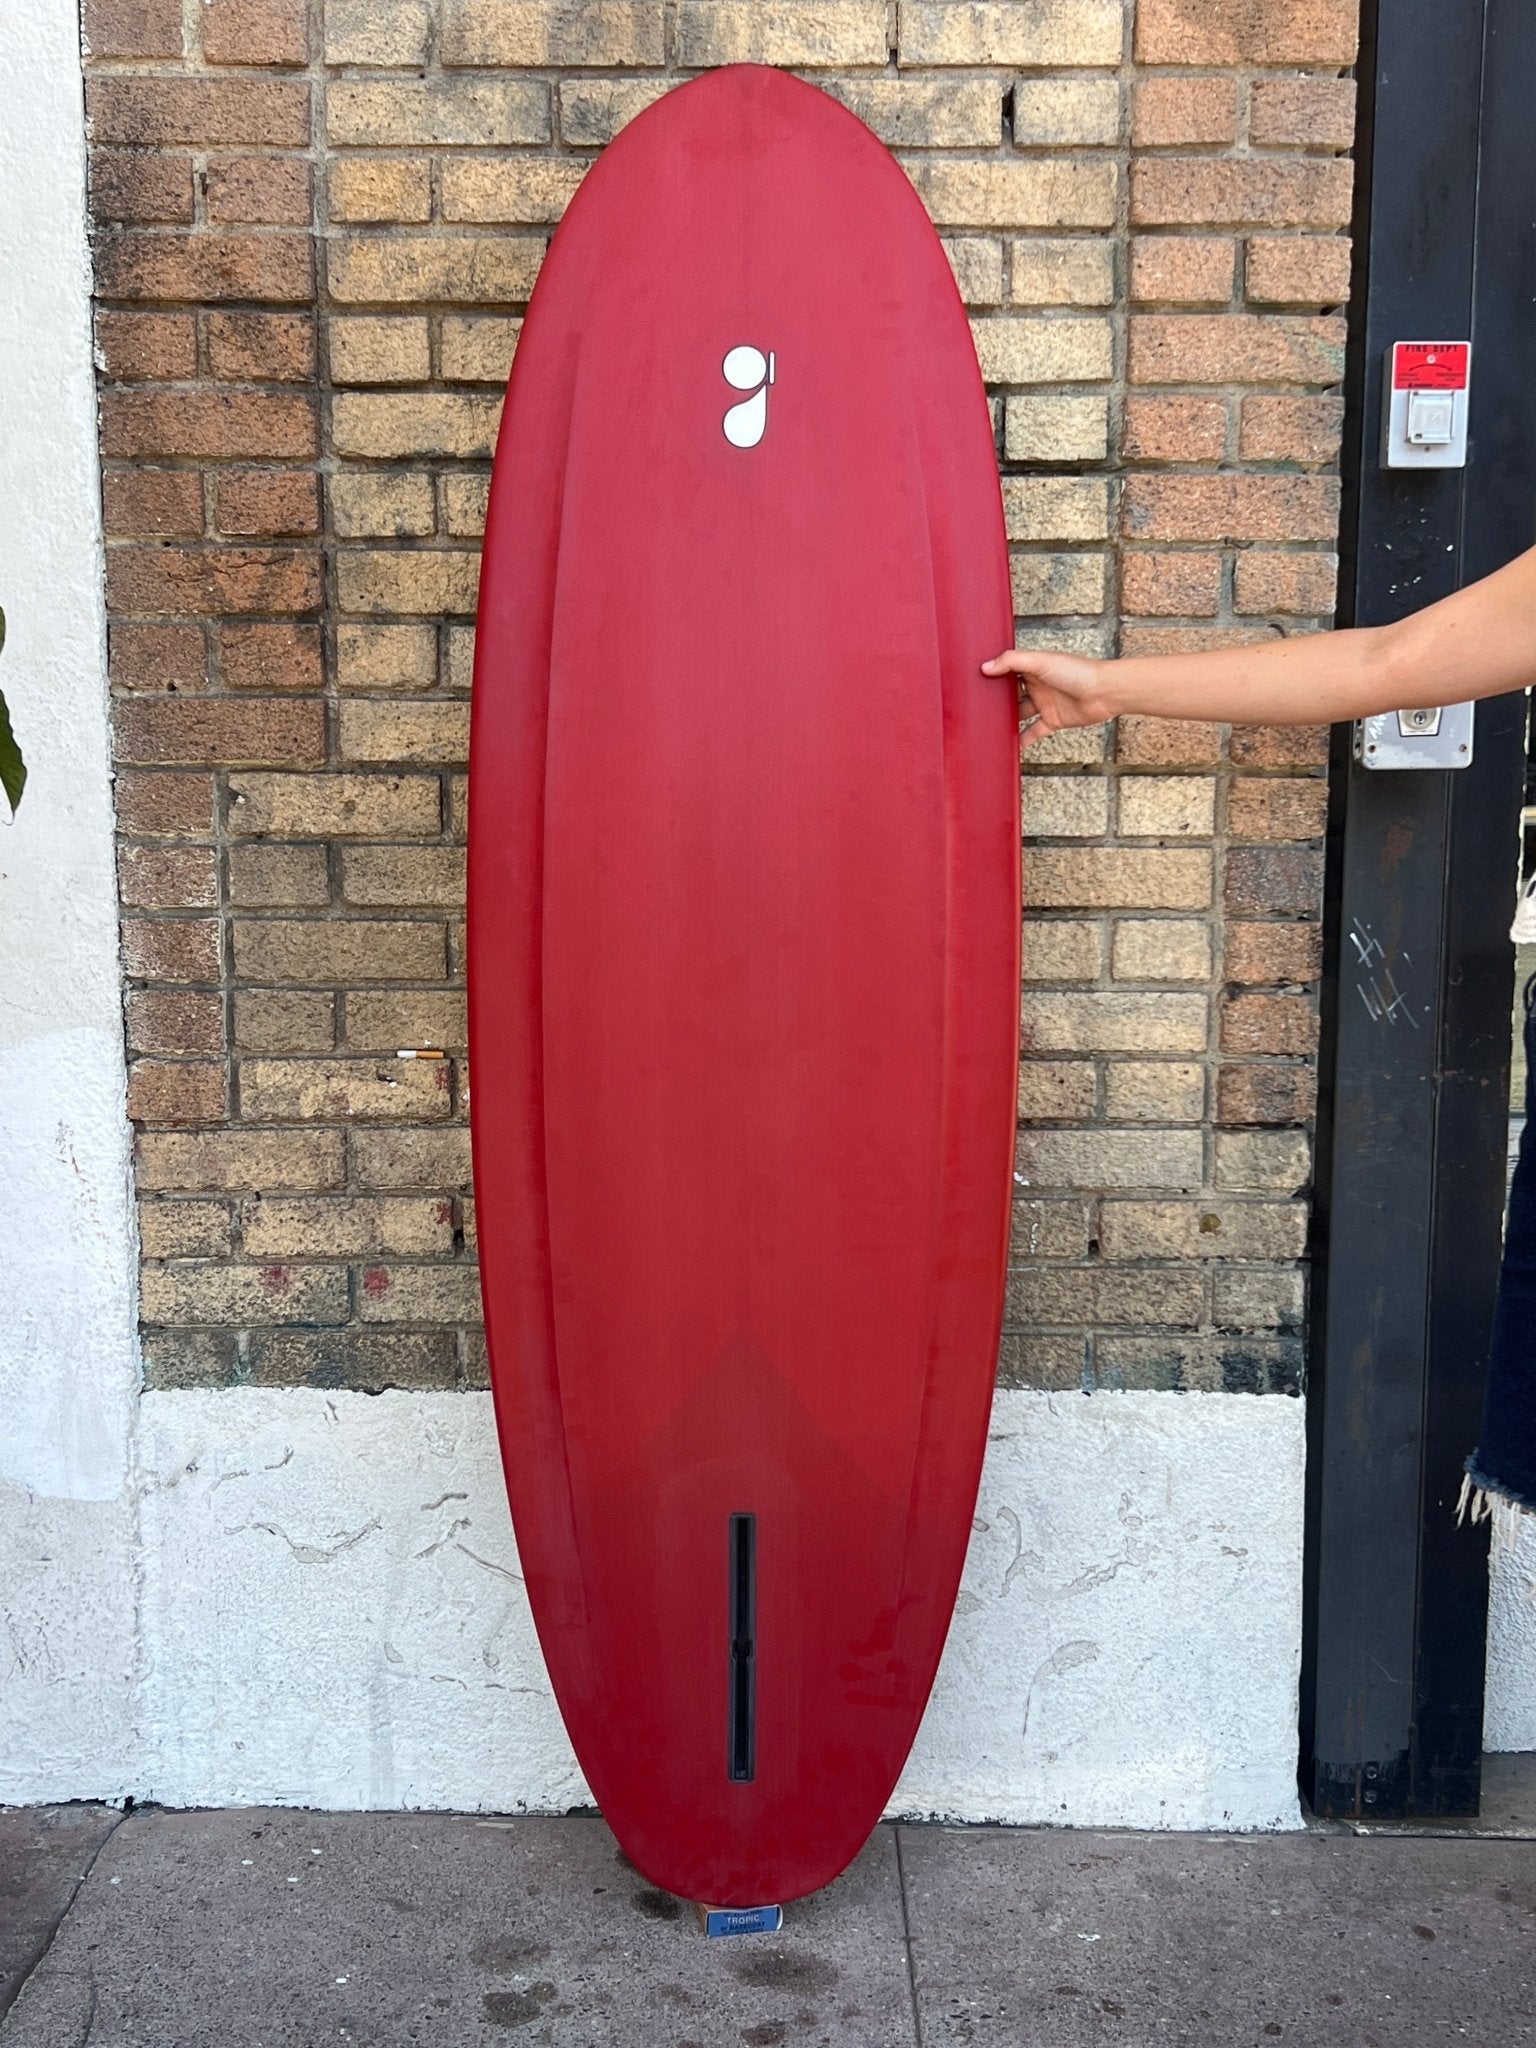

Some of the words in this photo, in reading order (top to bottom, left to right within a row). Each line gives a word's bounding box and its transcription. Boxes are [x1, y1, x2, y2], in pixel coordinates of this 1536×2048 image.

[1406, 344, 1428, 352] FIRE
[727, 1914, 760, 1925] TROPIC
[729, 1921, 766, 1931] BASECOAT
